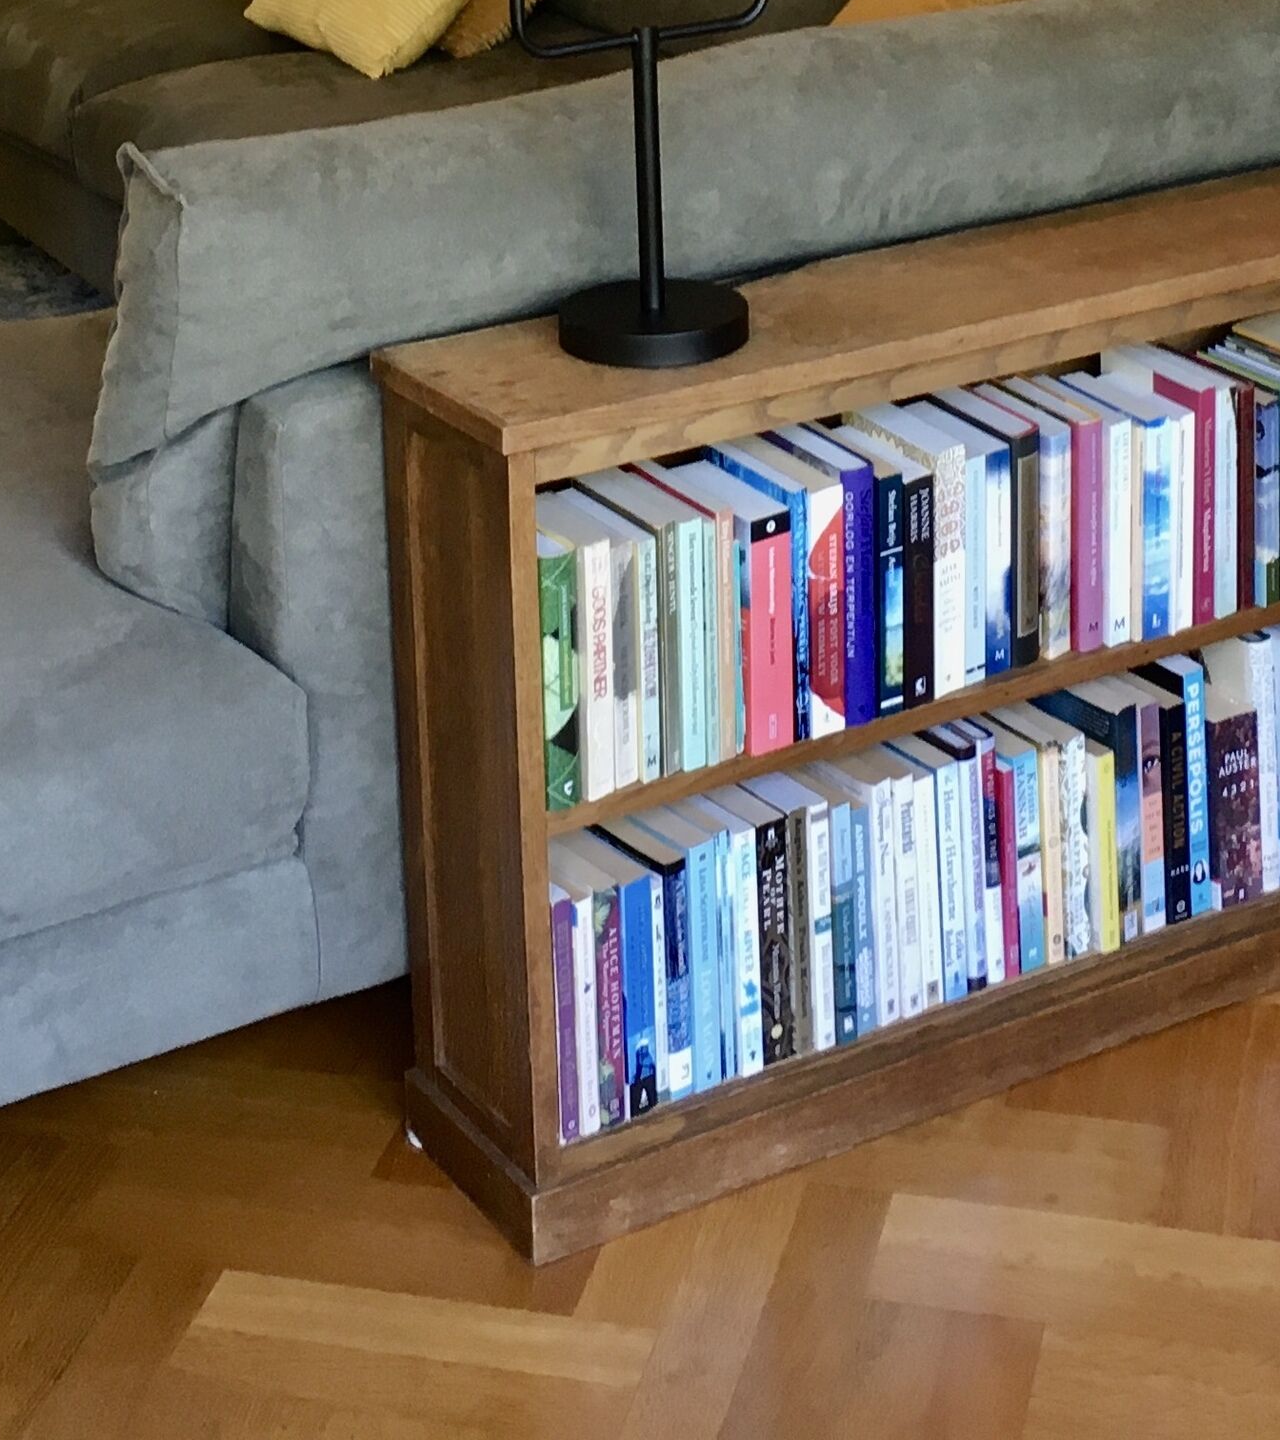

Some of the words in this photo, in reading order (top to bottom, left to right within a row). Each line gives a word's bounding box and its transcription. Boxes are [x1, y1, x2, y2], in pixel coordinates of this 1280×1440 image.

[845, 491, 854, 550] OORLOG
[920, 488, 929, 542] JOANNE
[829, 533, 837, 579] STEFAN
[846, 555, 855, 573] EN
[828, 583, 838, 615] BRIJS
[846, 578, 856, 658] TERPENTIJN
[829, 619, 838, 648] POST
[1088, 622, 1098, 632] M
[1115, 616, 1125, 631] M
[818, 620, 826, 677] BROMLEY
[830, 652, 838, 685] VOOR
[995, 649, 1004, 661] M
[1171, 730, 1180, 742] A
[1187, 682, 1203, 836] PERSEPOLIS
[1224, 749, 1250, 763] PAUL
[1171, 746, 1182, 790] CIVIL
[1218, 757, 1257, 779] AUSTER
[944, 789, 954, 832] House
[1016, 763, 1028, 839] HANNAH
[740, 834, 753, 881] PEACE
[855, 824, 864, 873] ANNIE
[762, 868, 771, 931] PEARL
[775, 855, 785, 935] MOTHER
[945, 846, 957, 921] Hawthorne
[857, 876, 867, 941] PROULX
[609, 928, 618, 975] ALICE
[744, 929, 754, 974] RIVER
[611, 980, 621, 1059] HOFFMAN
